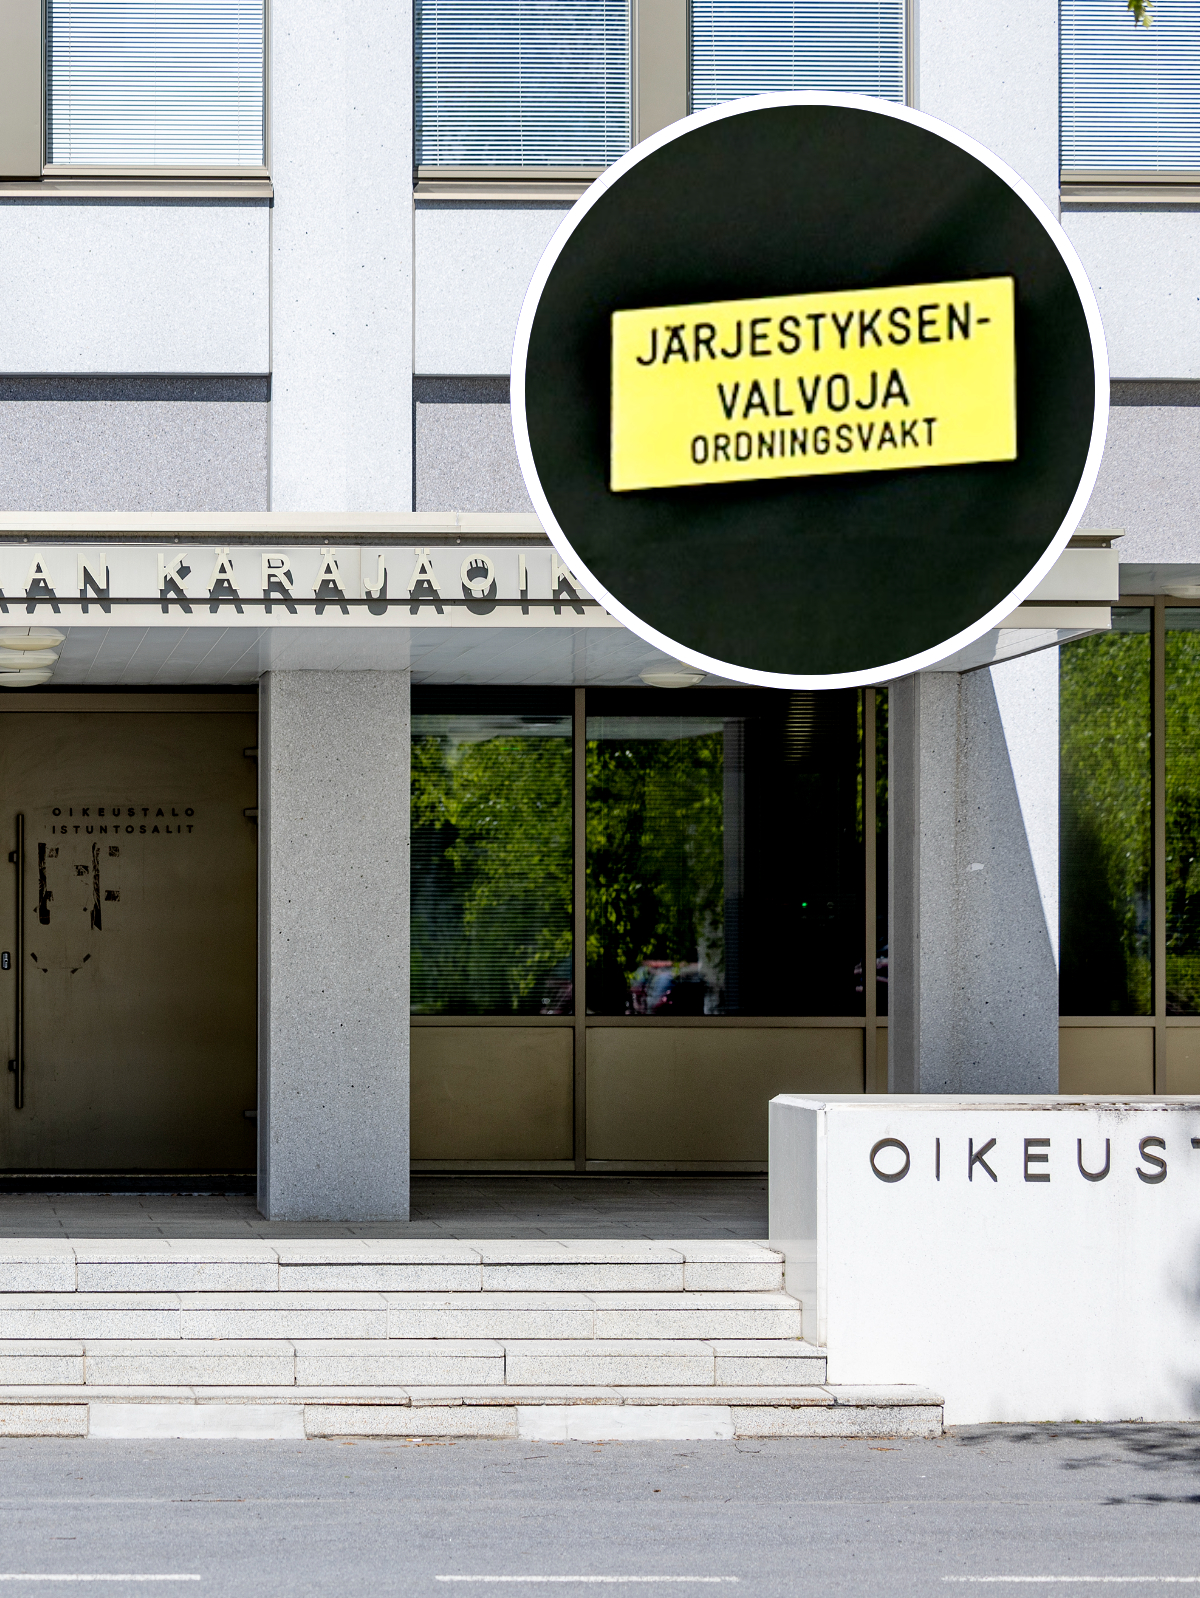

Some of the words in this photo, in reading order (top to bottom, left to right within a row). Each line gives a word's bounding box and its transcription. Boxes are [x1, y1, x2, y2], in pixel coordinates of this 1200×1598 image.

[636, 301, 991, 366] JÄRJESTYKSEN-
[717, 368, 909, 420] VALVOJA
[691, 417, 938, 465] ORDNINGSVAKT
[157, 547, 583, 592] KÄRÄJÄOIK
[52, 807, 195, 817] OIKEUSTALO
[52, 825, 194, 834] ISTUNTOSALIT
[869, 1136, 1200, 1185] OIKEUS
